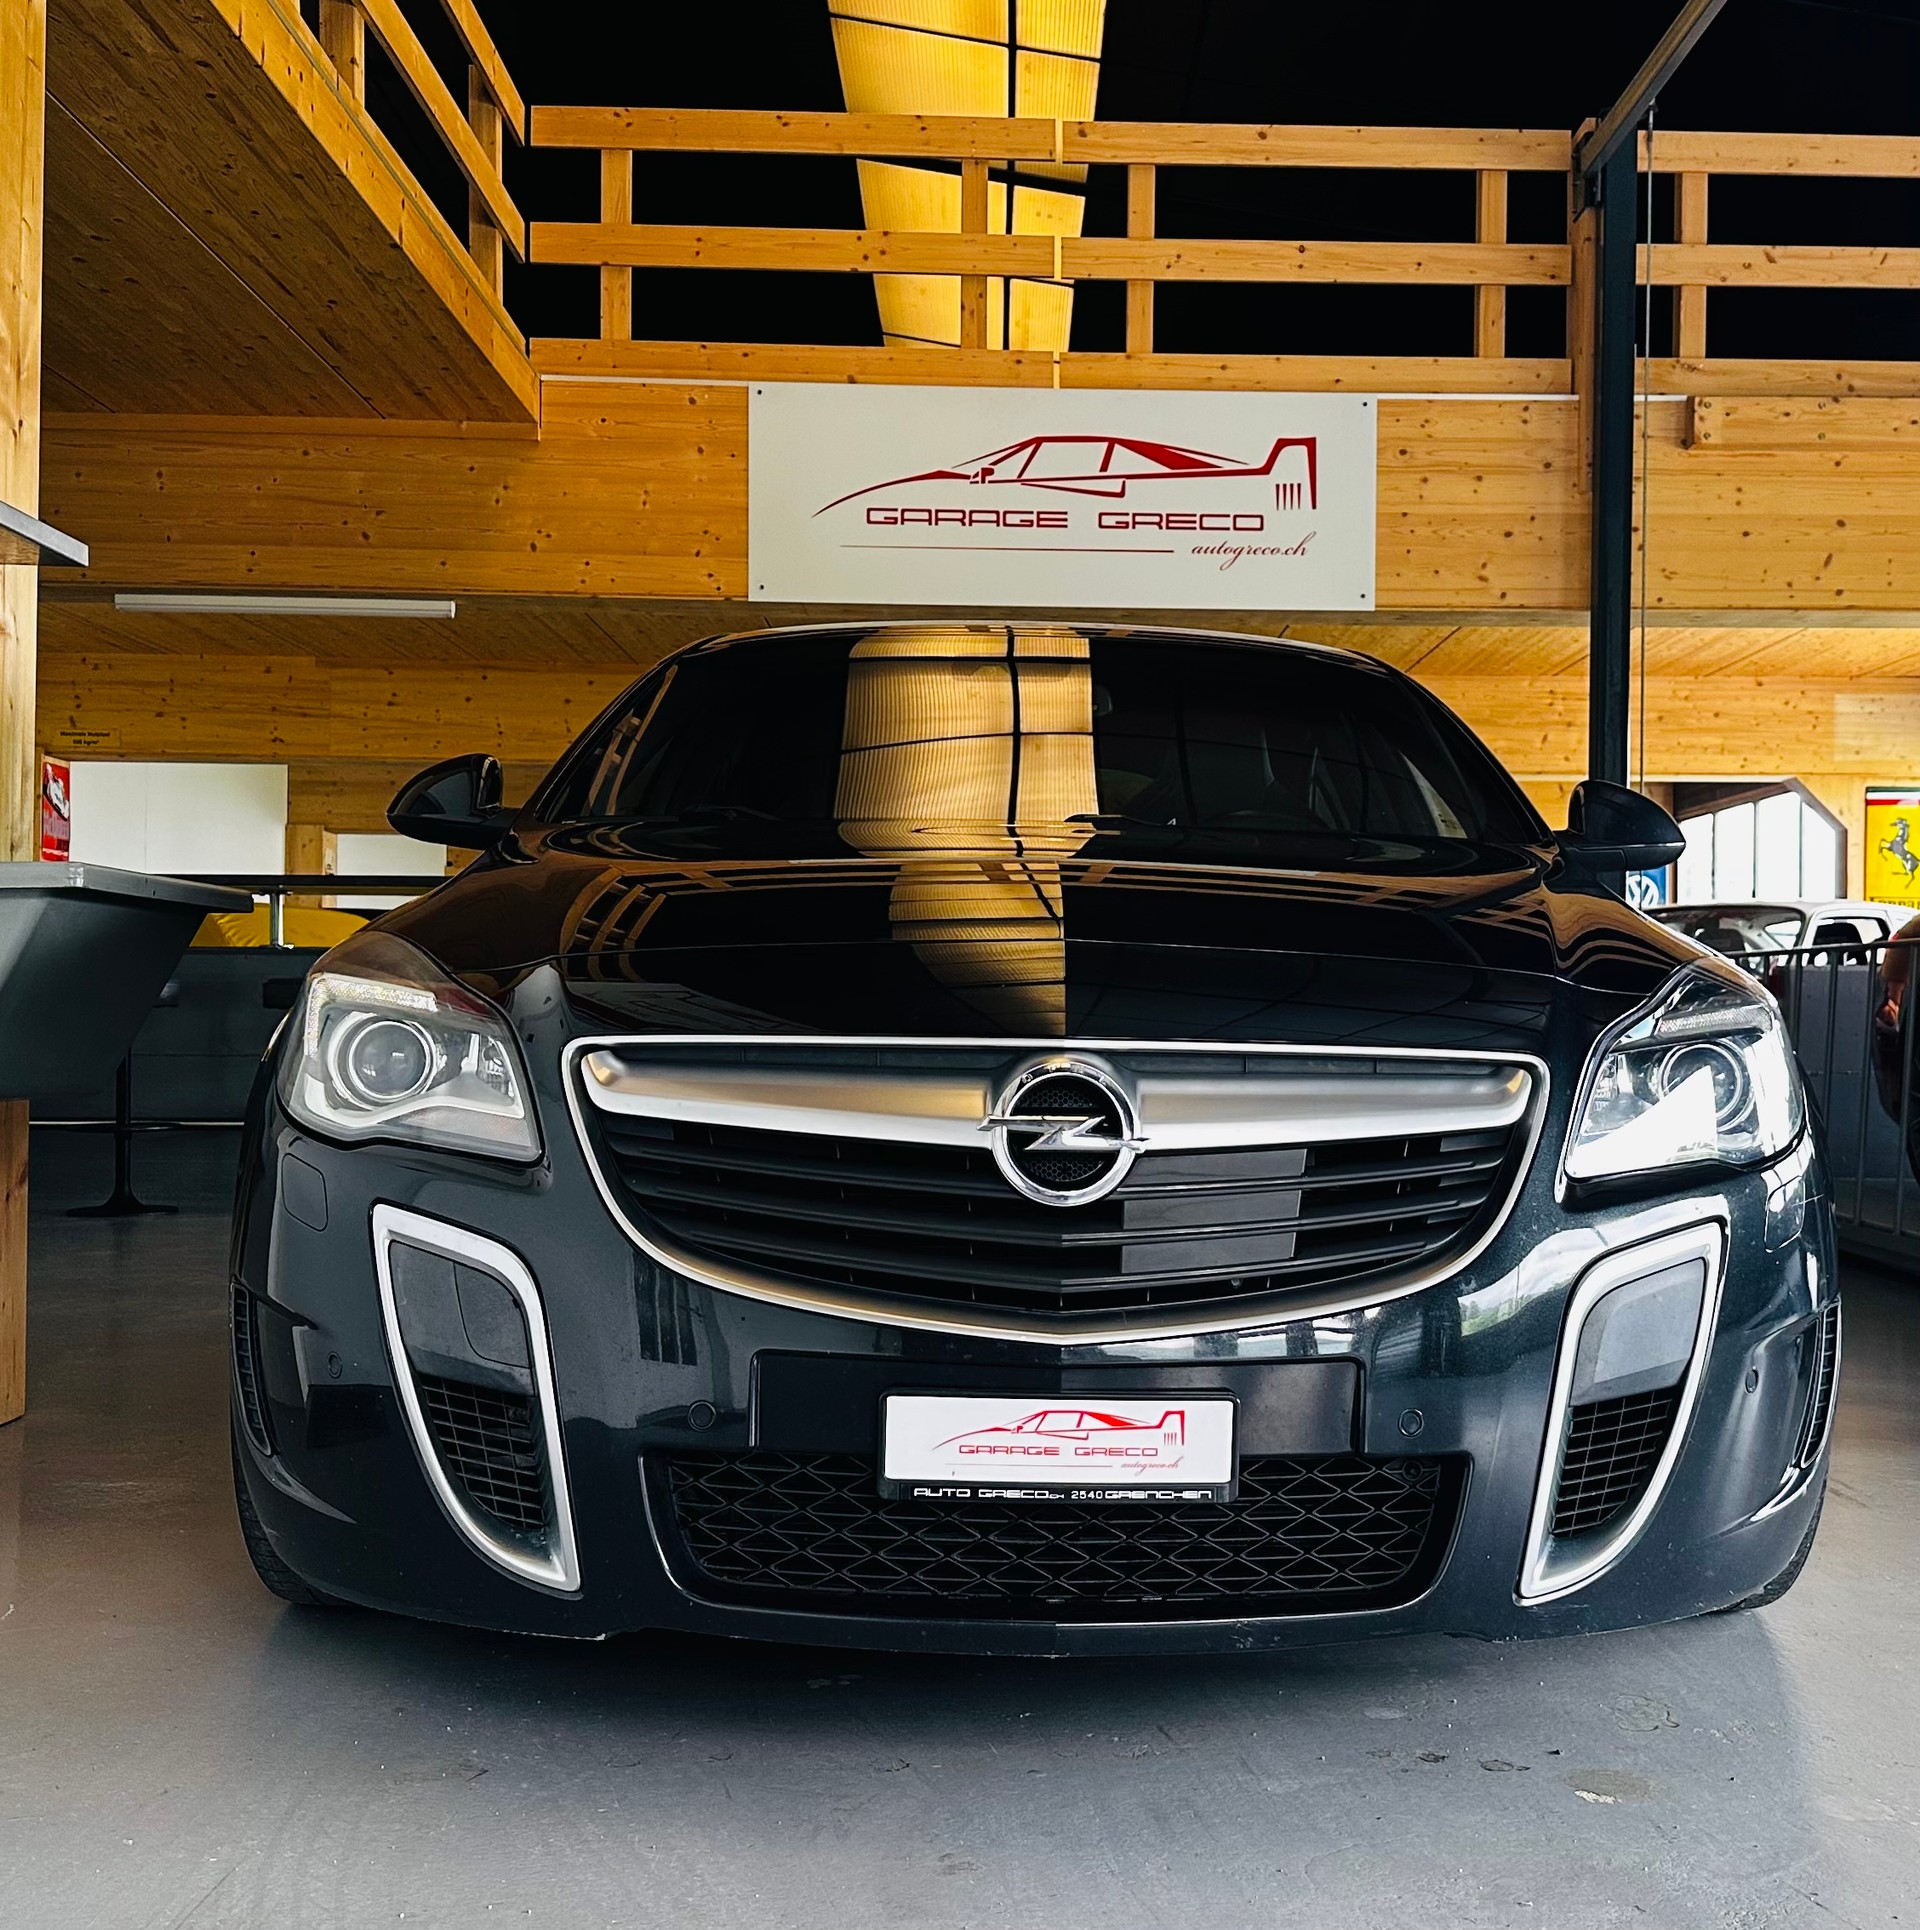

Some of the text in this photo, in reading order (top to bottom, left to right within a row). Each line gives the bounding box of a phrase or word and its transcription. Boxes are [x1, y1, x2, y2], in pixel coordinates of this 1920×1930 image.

[866, 507, 1265, 532] GARAGE GRECO
[1191, 530, 1317, 572] autogreco.ch
[958, 1444, 1159, 1457] GARAGE GRECO
[913, 1487, 971, 1498] AUTO
[1070, 1490, 1103, 1499] 2540
[1104, 1490, 1212, 1499] GRENCHEN
